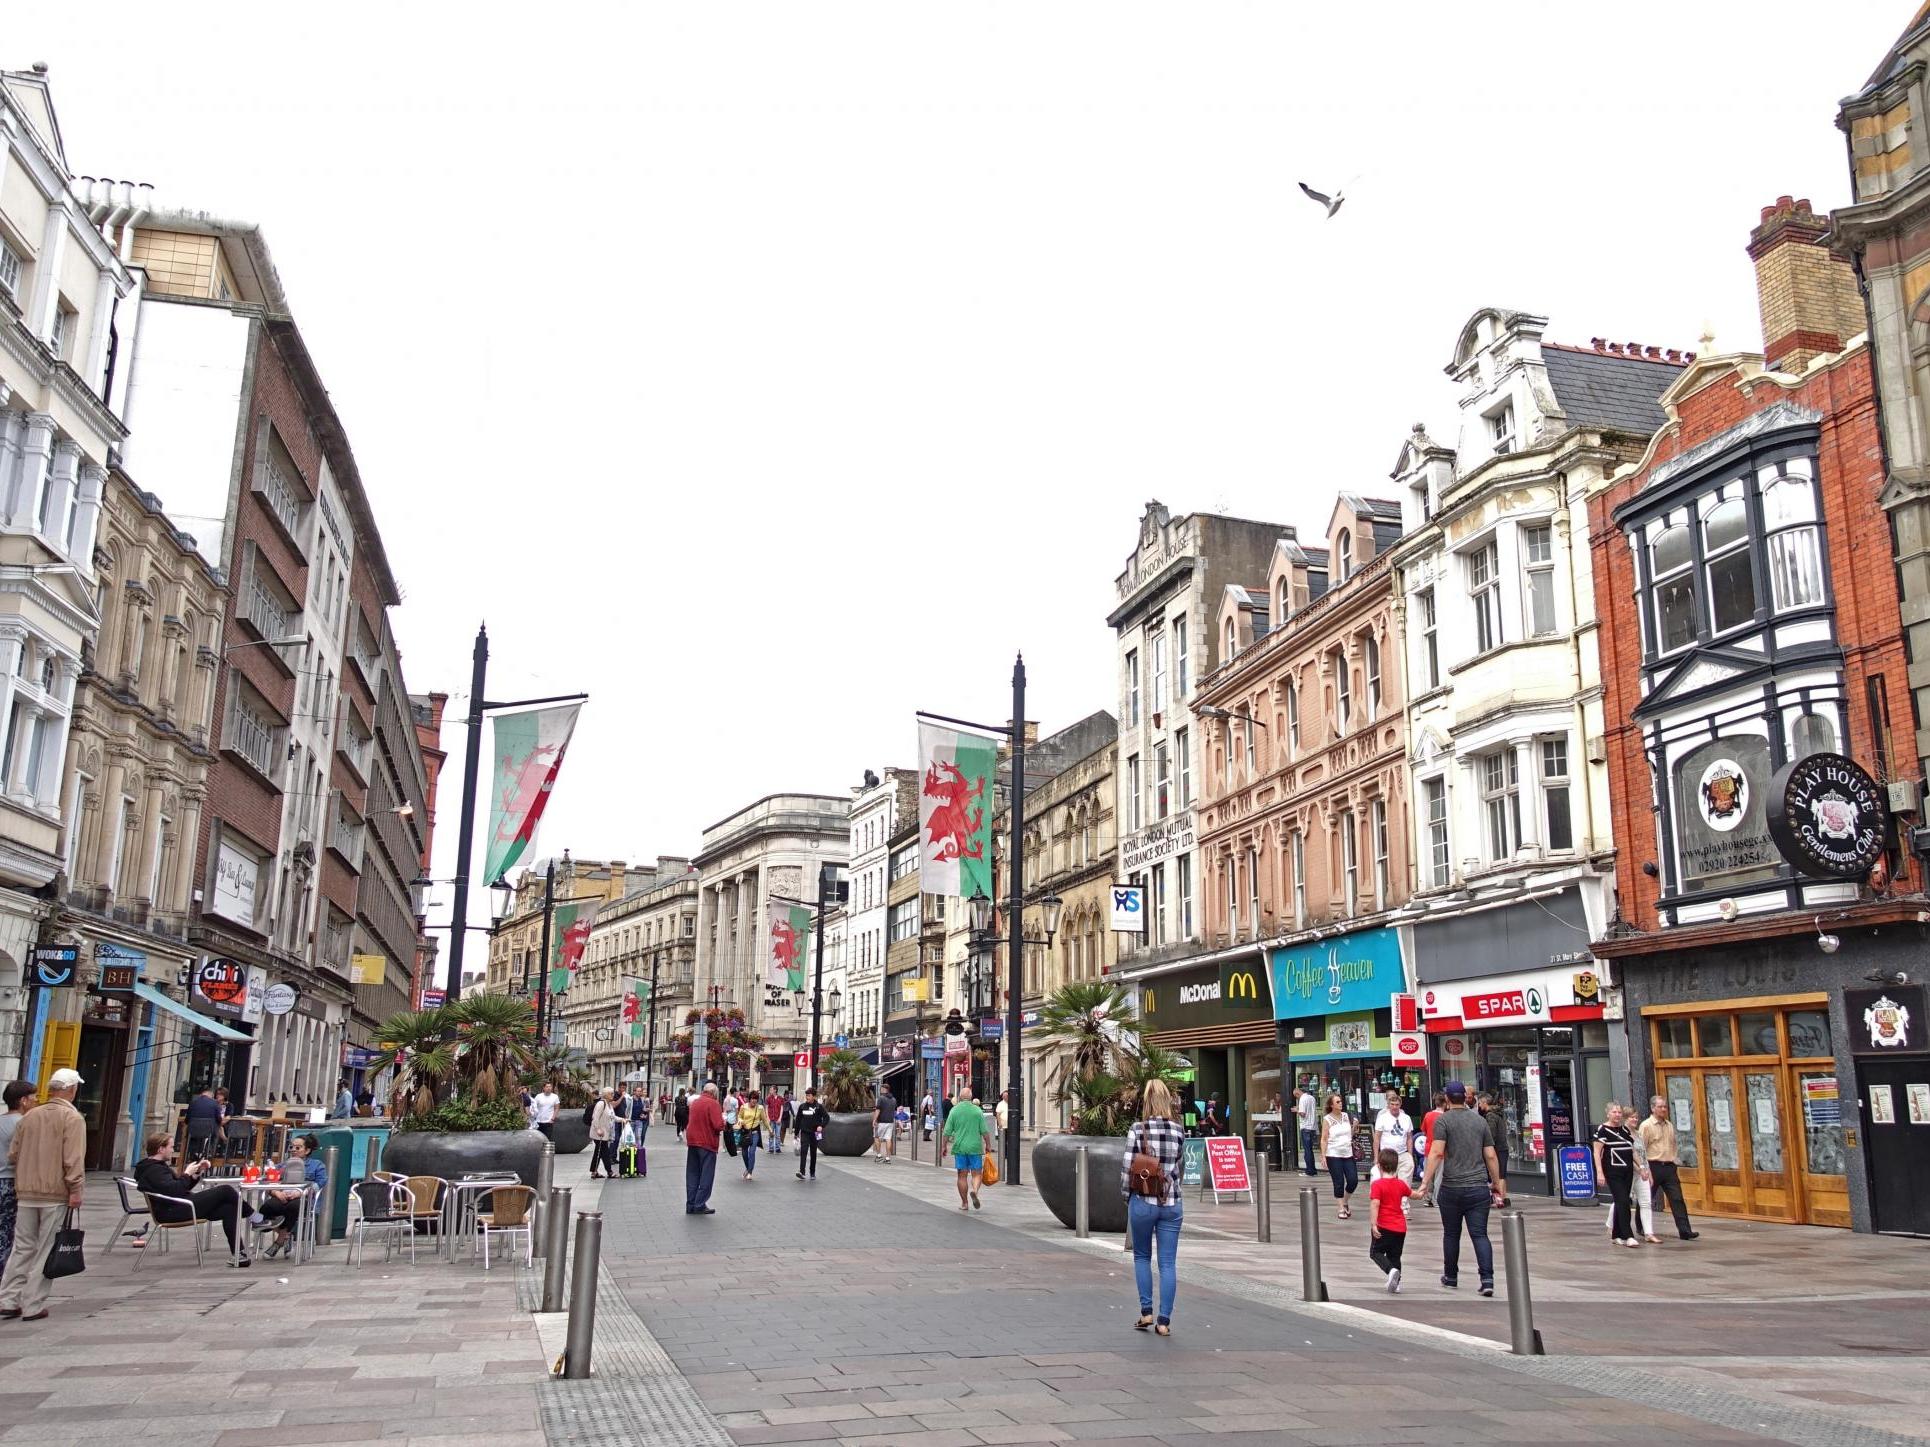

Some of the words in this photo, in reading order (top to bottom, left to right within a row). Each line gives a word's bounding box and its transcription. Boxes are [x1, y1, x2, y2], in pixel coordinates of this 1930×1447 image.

[1138, 553, 1164, 585] LONDON
[1166, 534, 1188, 563] HOUSE
[1795, 769, 1822, 809] PLAY
[1827, 767, 1873, 813] HOUSE
[1123, 836, 1139, 854] ROYAL
[1141, 827, 1164, 847] LONDON
[1166, 815, 1193, 836] MUTUAL
[1801, 824, 1857, 862] Gentlemens
[1856, 828, 1874, 854] Club
[1123, 847, 1153, 870] INSURANCE
[1154, 836, 1180, 858] SOCIETY
[1698, 859, 1725, 873] 02920
[37, 949, 76, 960] WOK&GO
[1285, 956, 1324, 998] Coffee
[1328, 947, 1374, 989] Heaven
[771, 990, 782, 998] OF
[1478, 995, 1524, 1014] SPAR
[1565, 1162, 1587, 1171] FREE
[1567, 1172, 1588, 1180] CASH
